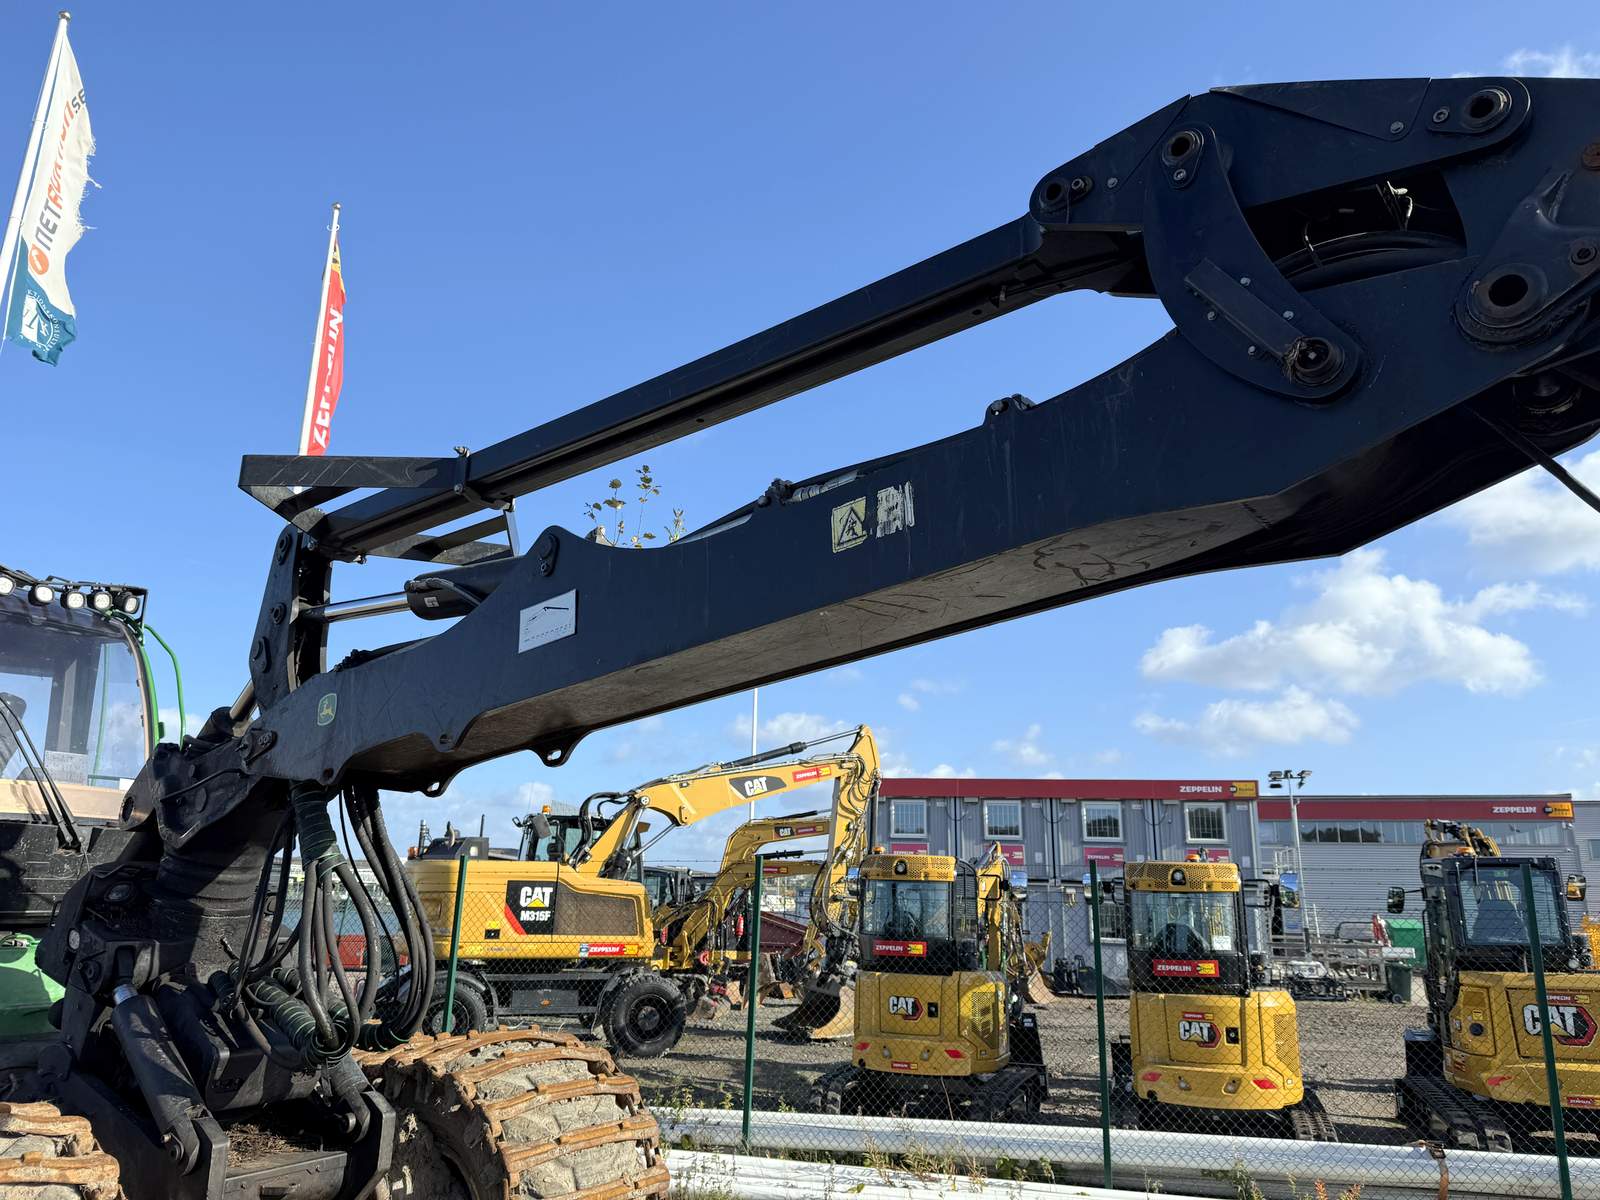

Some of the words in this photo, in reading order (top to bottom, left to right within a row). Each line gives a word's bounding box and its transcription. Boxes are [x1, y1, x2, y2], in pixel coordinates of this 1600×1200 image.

[744, 777, 768, 796] CAT
[1179, 785, 1222, 793] ZEPPELIN
[1492, 806, 1537, 814] ZEPPELIN
[780, 828, 791, 837] CAT
[519, 886, 553, 908] CAT
[520, 910, 551, 922] M315F
[875, 944, 903, 952] ZEPPELIN
[1157, 964, 1192, 972] ZEPPELIN
[889, 996, 915, 1016] CAT
[1523, 1004, 1577, 1036] CAT
[1180, 1020, 1211, 1042] CAT
